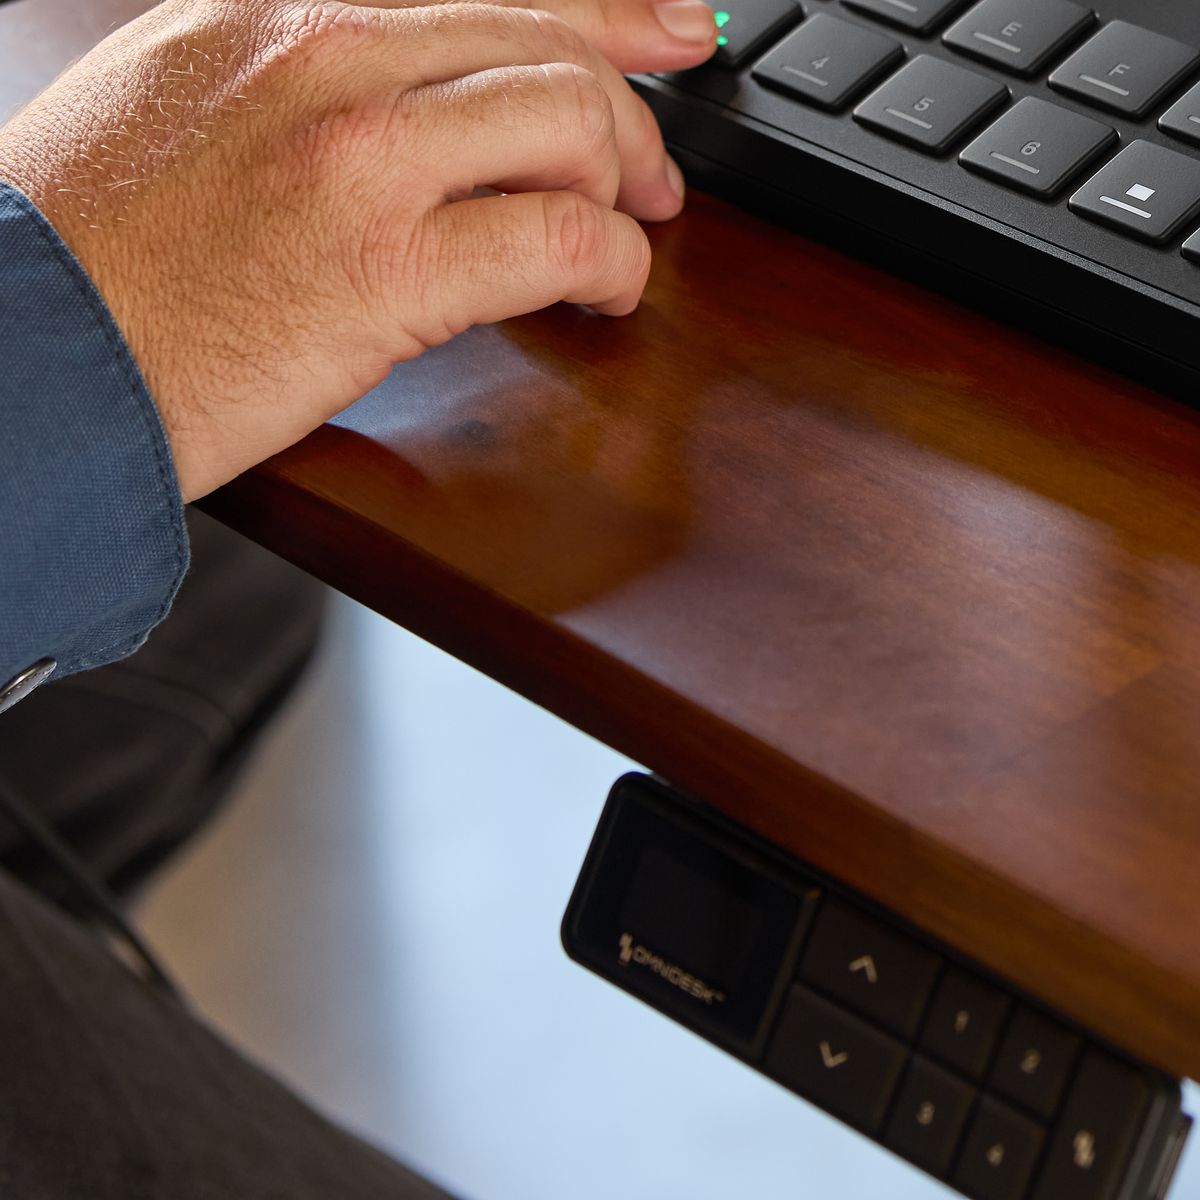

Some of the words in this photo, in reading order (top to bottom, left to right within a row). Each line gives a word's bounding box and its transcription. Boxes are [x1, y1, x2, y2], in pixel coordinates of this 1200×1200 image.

[1001, 21, 1023, 37] E
[811, 56, 831, 70] 4
[1108, 63, 1131, 78] F
[914, 96, 935, 112] 5
[1020, 141, 1041, 156] 6
